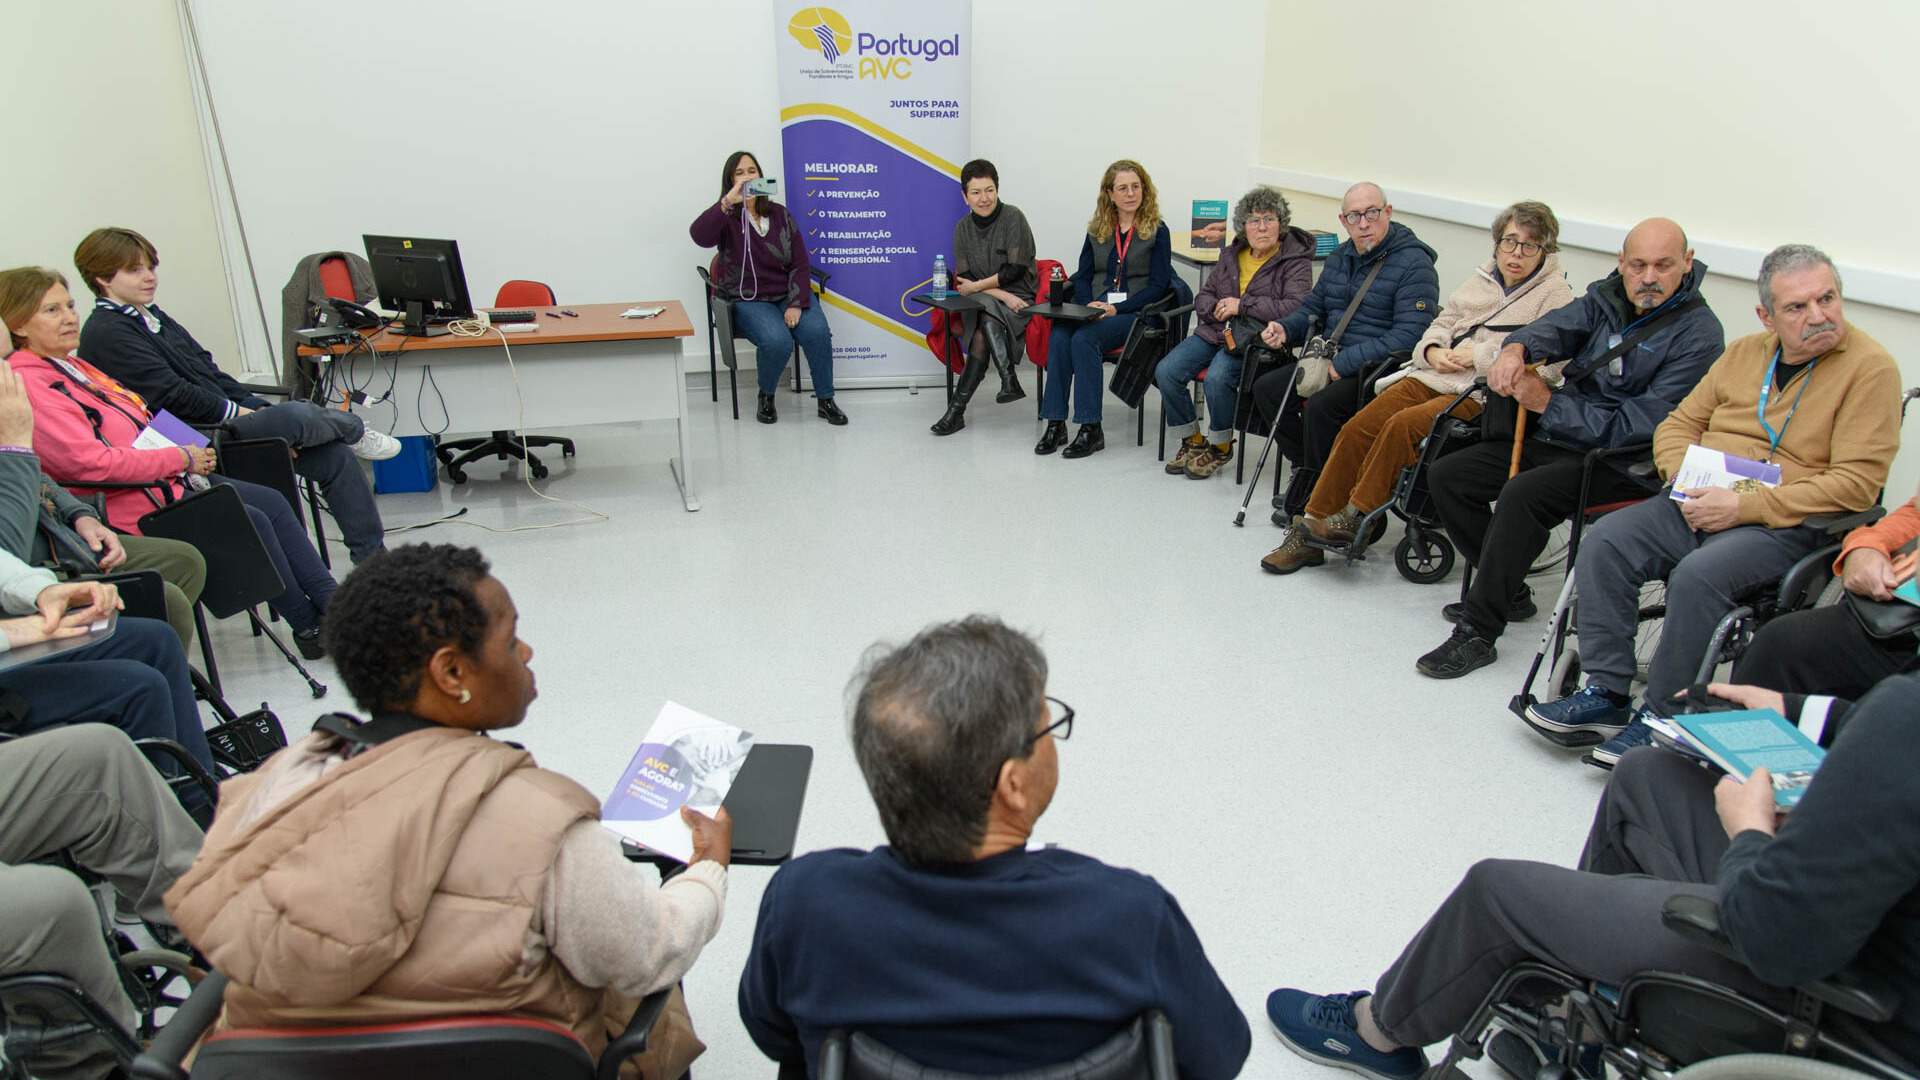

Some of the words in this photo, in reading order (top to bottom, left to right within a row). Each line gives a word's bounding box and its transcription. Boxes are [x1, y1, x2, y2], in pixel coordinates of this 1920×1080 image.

[858, 33, 959, 62] Portugal
[859, 57, 912, 80] AVC
[890, 100, 929, 108] JUNTOS
[931, 100, 959, 108] PARA
[910, 110, 959, 118] SUPERAR!
[804, 163, 879, 174] MELHORAR:
[827, 189, 880, 199] PREVENÇÃO
[827, 211, 887, 219] TRATAMENTO
[820, 231, 826, 239] A
[828, 229, 892, 240] REABILITAÇÃO
[828, 246, 883, 257] REINSERÇÃO
[885, 246, 917, 254] SOCIAL
[827, 256, 891, 264] PROFISSIONAL
[643, 757, 670, 773] AVC
[669, 766, 679, 778] E
[637, 766, 686, 793] AGORA?
